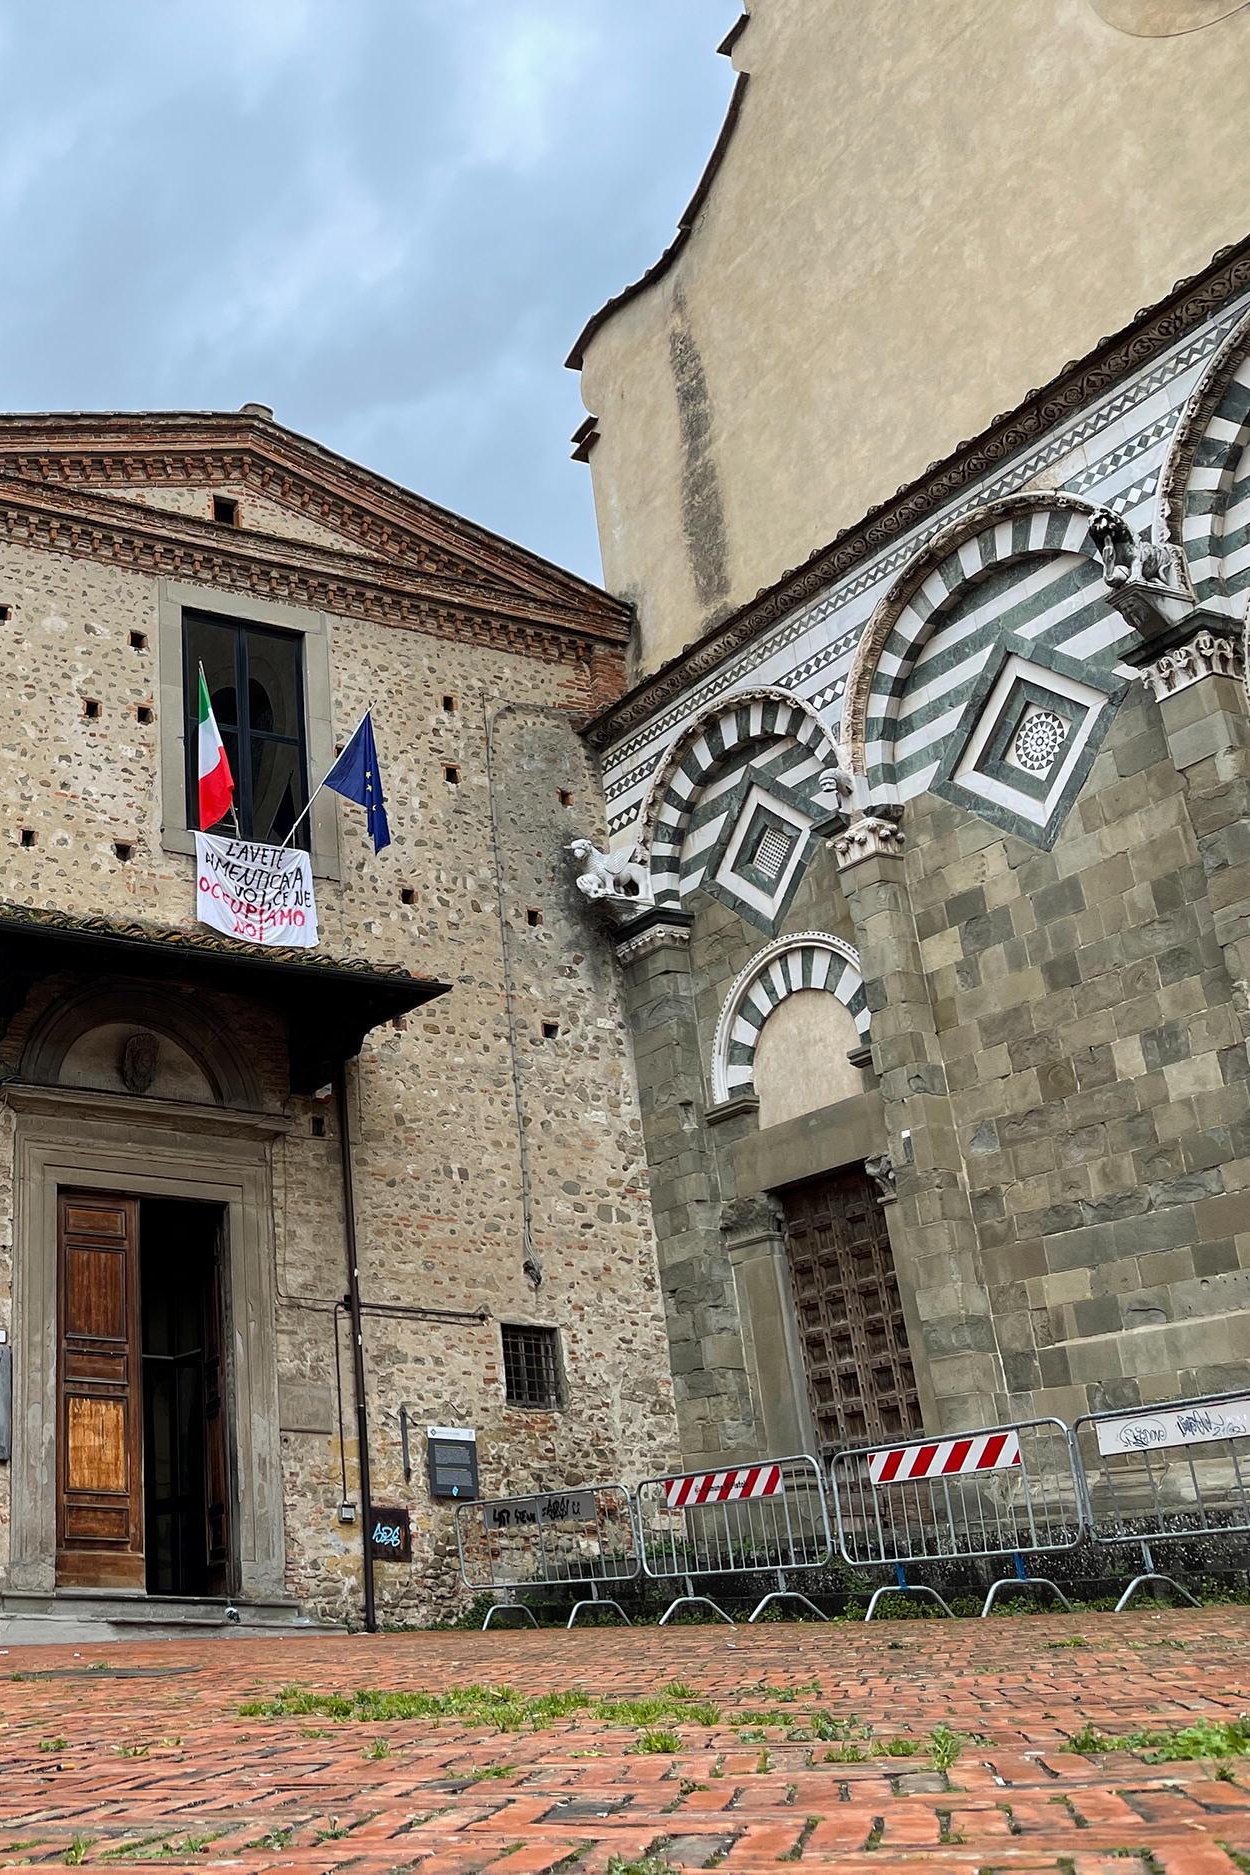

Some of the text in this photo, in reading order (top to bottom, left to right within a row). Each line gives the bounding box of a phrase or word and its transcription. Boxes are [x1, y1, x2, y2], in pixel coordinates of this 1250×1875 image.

[205, 852, 304, 890] DIMENTICAA
[226, 842, 286, 870] L'AVETE
[199, 876, 306, 927] OCCUPIAMO
[273, 890, 289, 907] CE
[294, 889, 312, 908] NE
